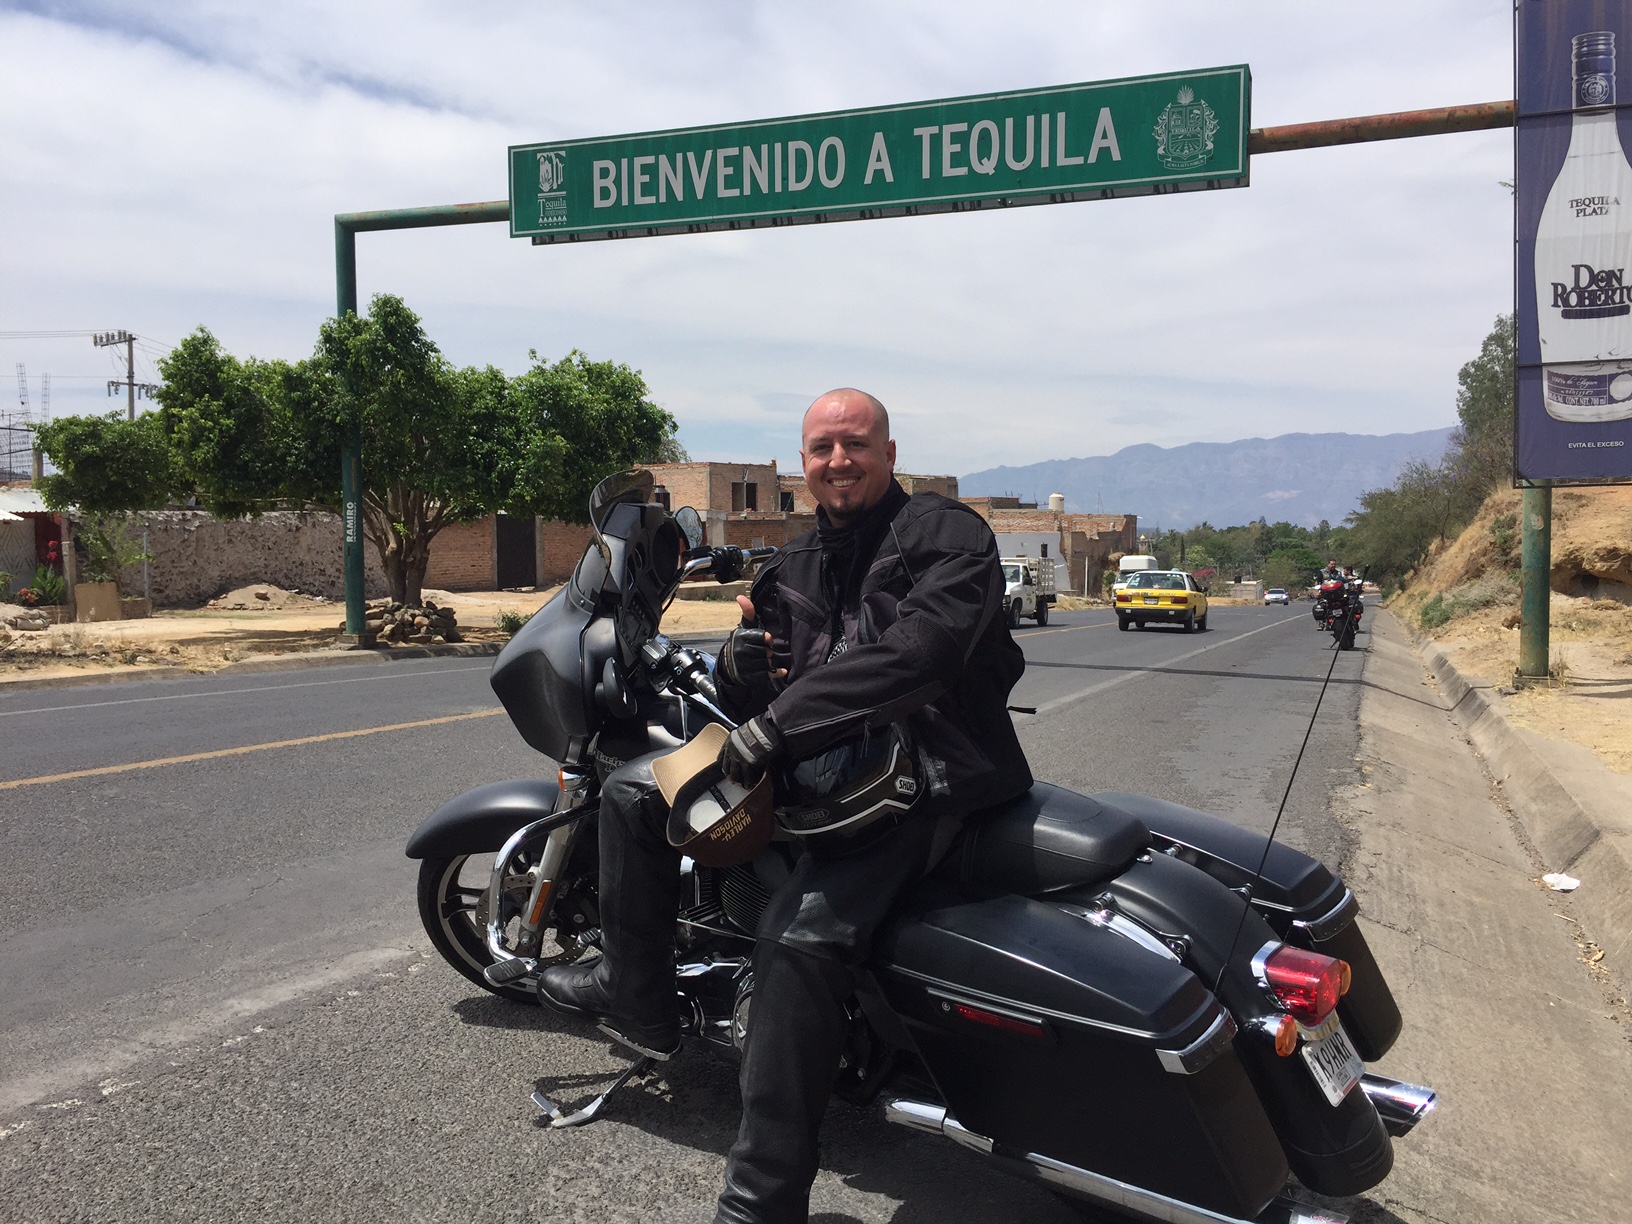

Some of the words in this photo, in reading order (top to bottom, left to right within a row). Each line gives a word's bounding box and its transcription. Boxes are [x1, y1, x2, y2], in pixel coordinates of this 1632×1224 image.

[593, 136, 846, 209] BIENVENIDO
[863, 131, 895, 185] A
[913, 106, 1122, 180] TEQUILA
[346, 501, 354, 543] RAMIRO
[898, 779, 915, 792] SHOEI
[709, 808, 746, 841] DAVIDSON
[800, 809, 826, 822] SHOEI
